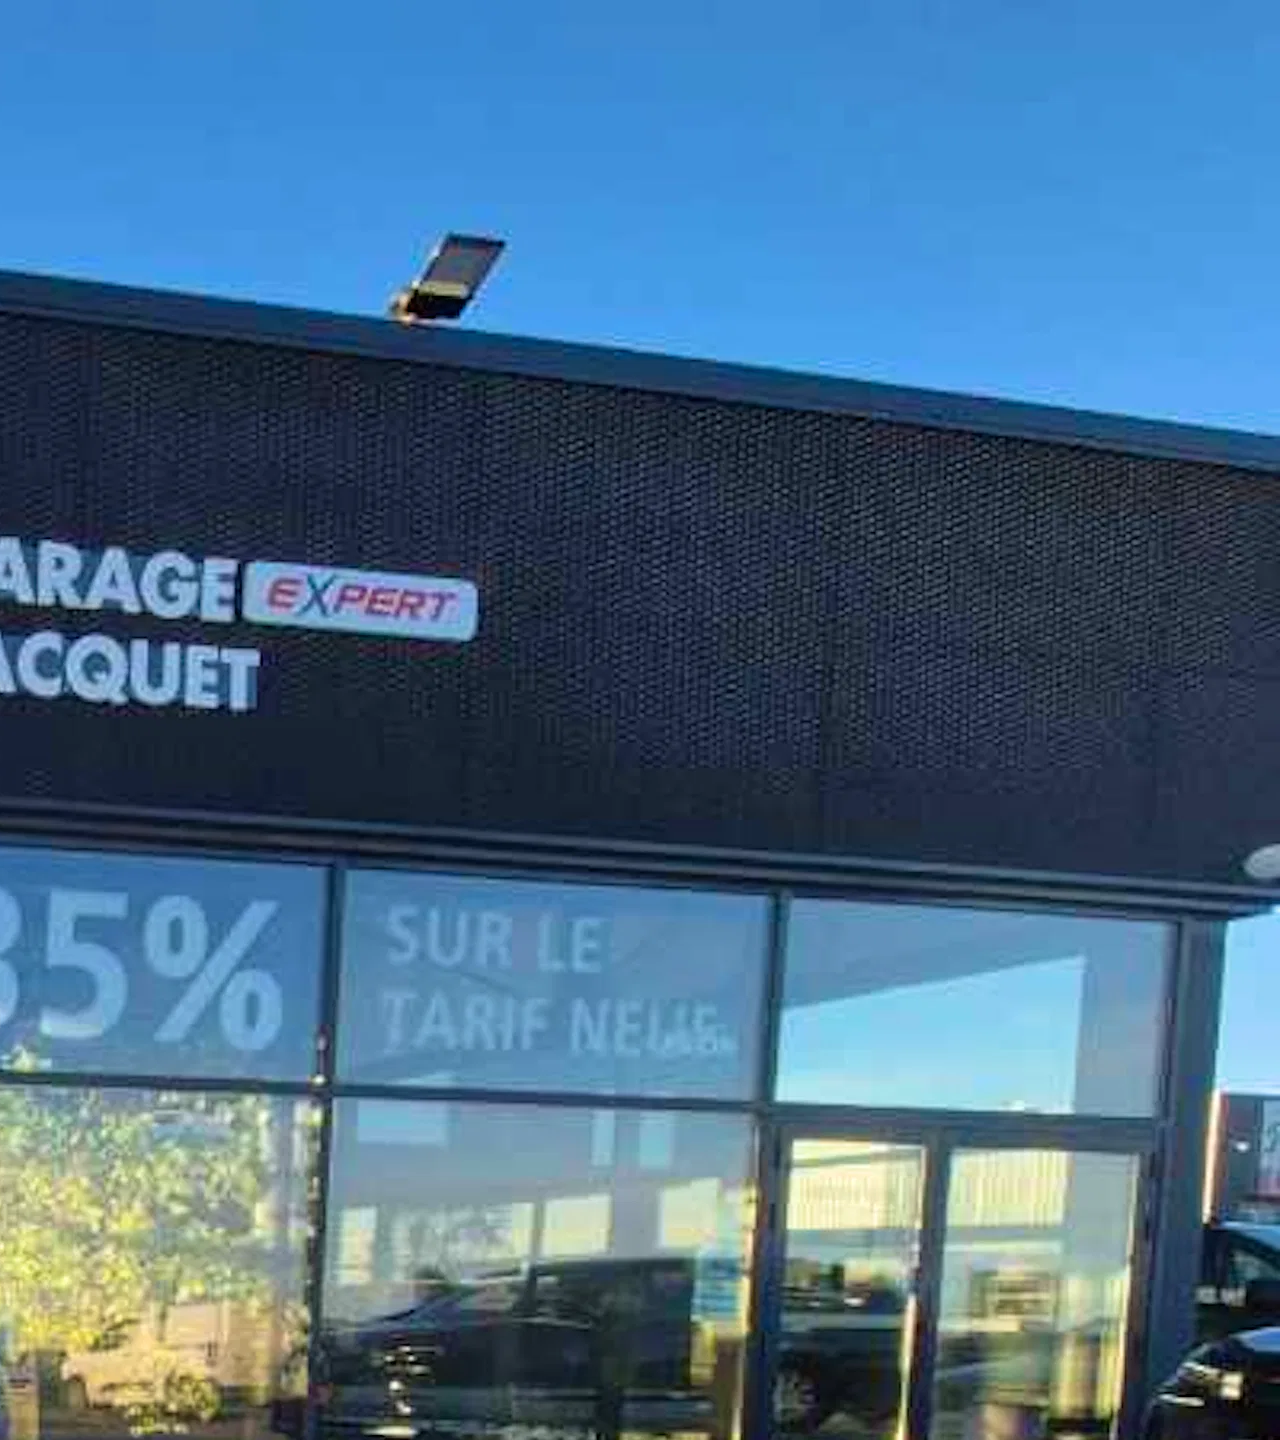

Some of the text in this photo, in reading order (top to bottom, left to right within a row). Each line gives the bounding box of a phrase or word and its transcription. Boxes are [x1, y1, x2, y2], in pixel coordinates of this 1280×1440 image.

[384, 903, 607, 974] SUR LE
[380, 992, 550, 1056] TARIF
